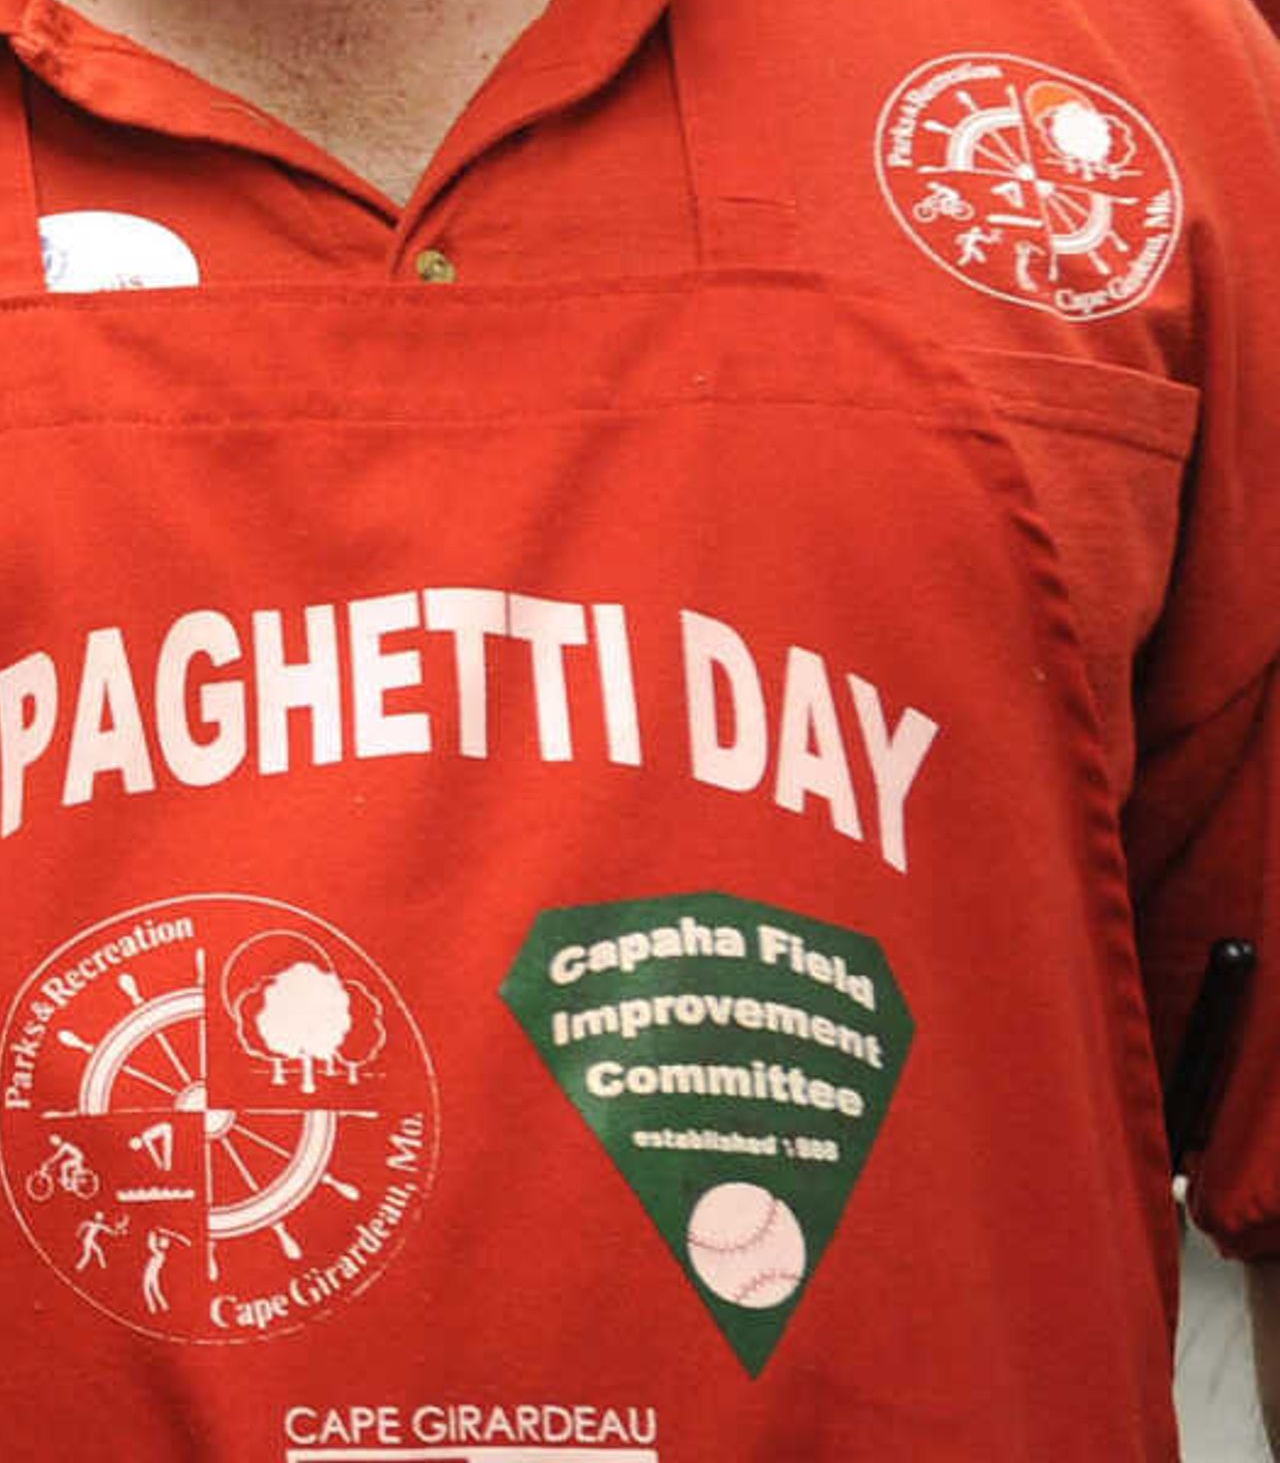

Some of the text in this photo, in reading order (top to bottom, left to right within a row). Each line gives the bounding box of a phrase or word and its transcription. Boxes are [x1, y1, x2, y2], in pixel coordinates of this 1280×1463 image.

[679, 608, 938, 875] DAY
[548, 916, 876, 1011] Capaha Field
[5, 1018, 47, 1109] Parks
[41, 917, 194, 1008] Recreation
[551, 993, 884, 1069] Improvement
[585, 1060, 866, 1118] Committee
[633, 1128, 777, 1156] established
[209, 1293, 290, 1330] Cape
[284, 1404, 658, 1445] CAPE GIRARDEAU
